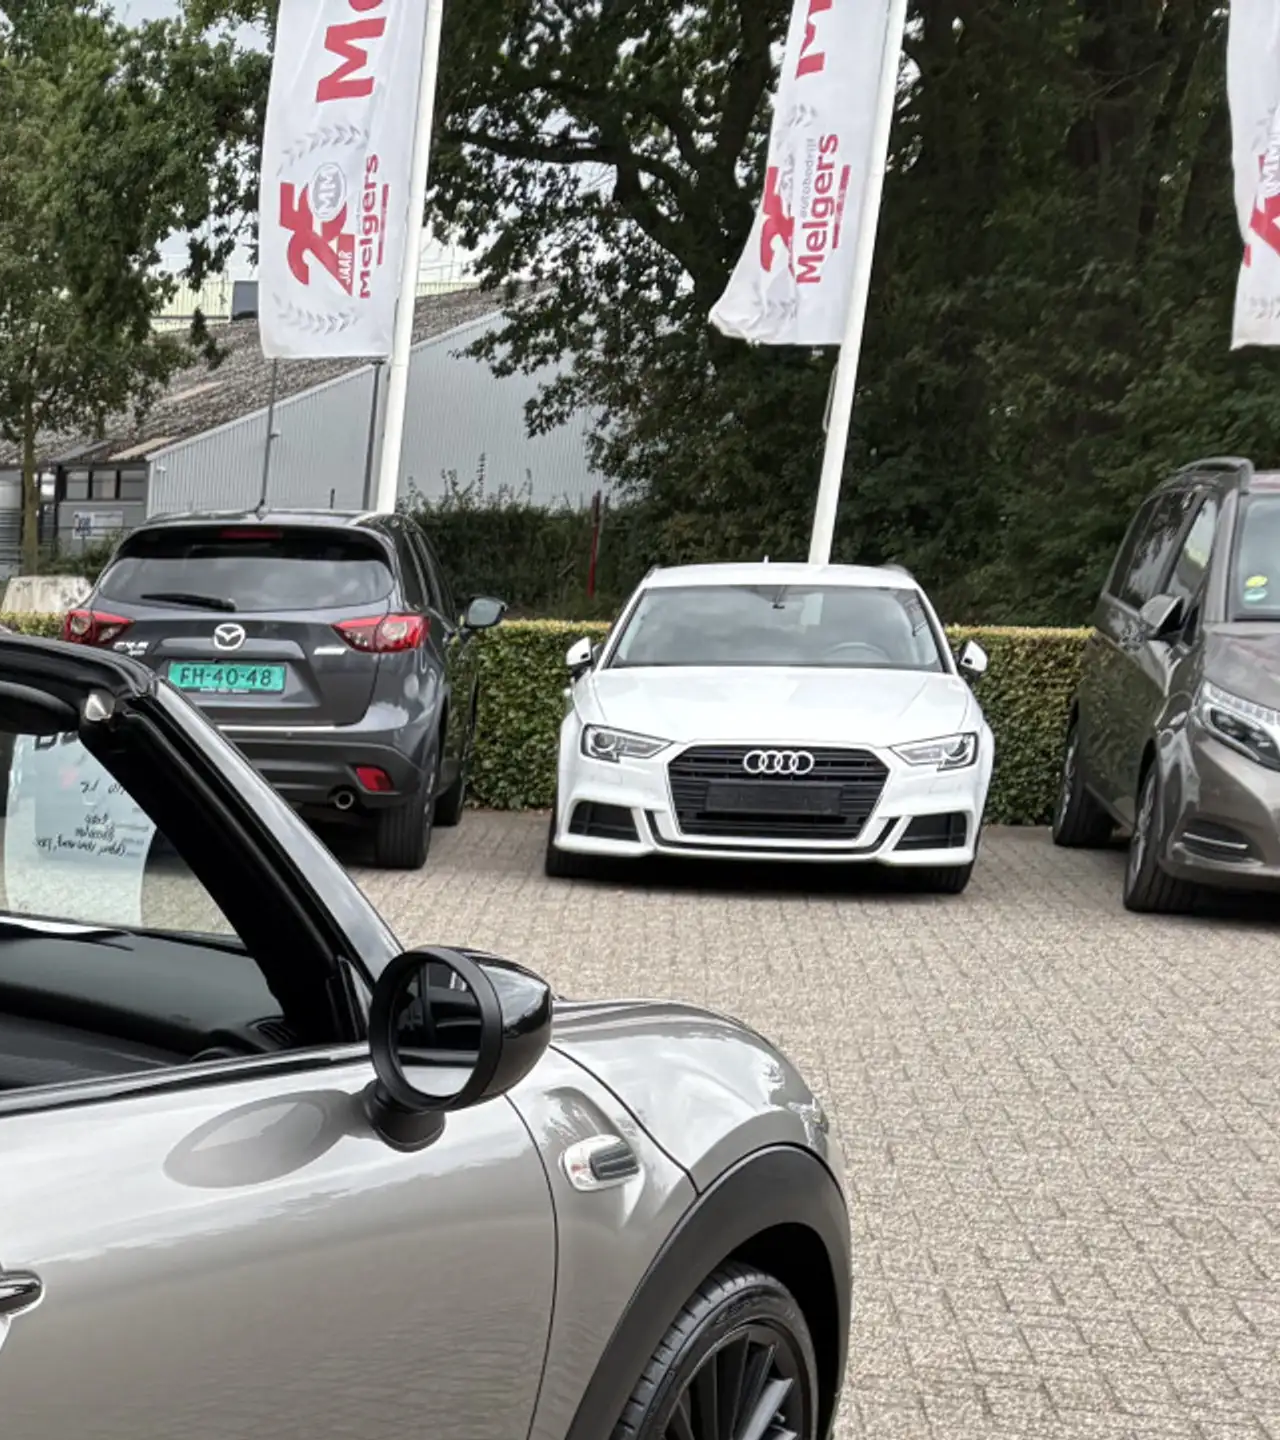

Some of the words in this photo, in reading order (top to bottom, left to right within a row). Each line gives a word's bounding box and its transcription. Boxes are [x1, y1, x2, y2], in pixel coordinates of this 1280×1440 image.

[359, 153, 380, 299] Melgers
[796, 133, 839, 285] Melgers
[338, 250, 353, 285] JAAR
[179, 667, 273, 687] FH-40-48
